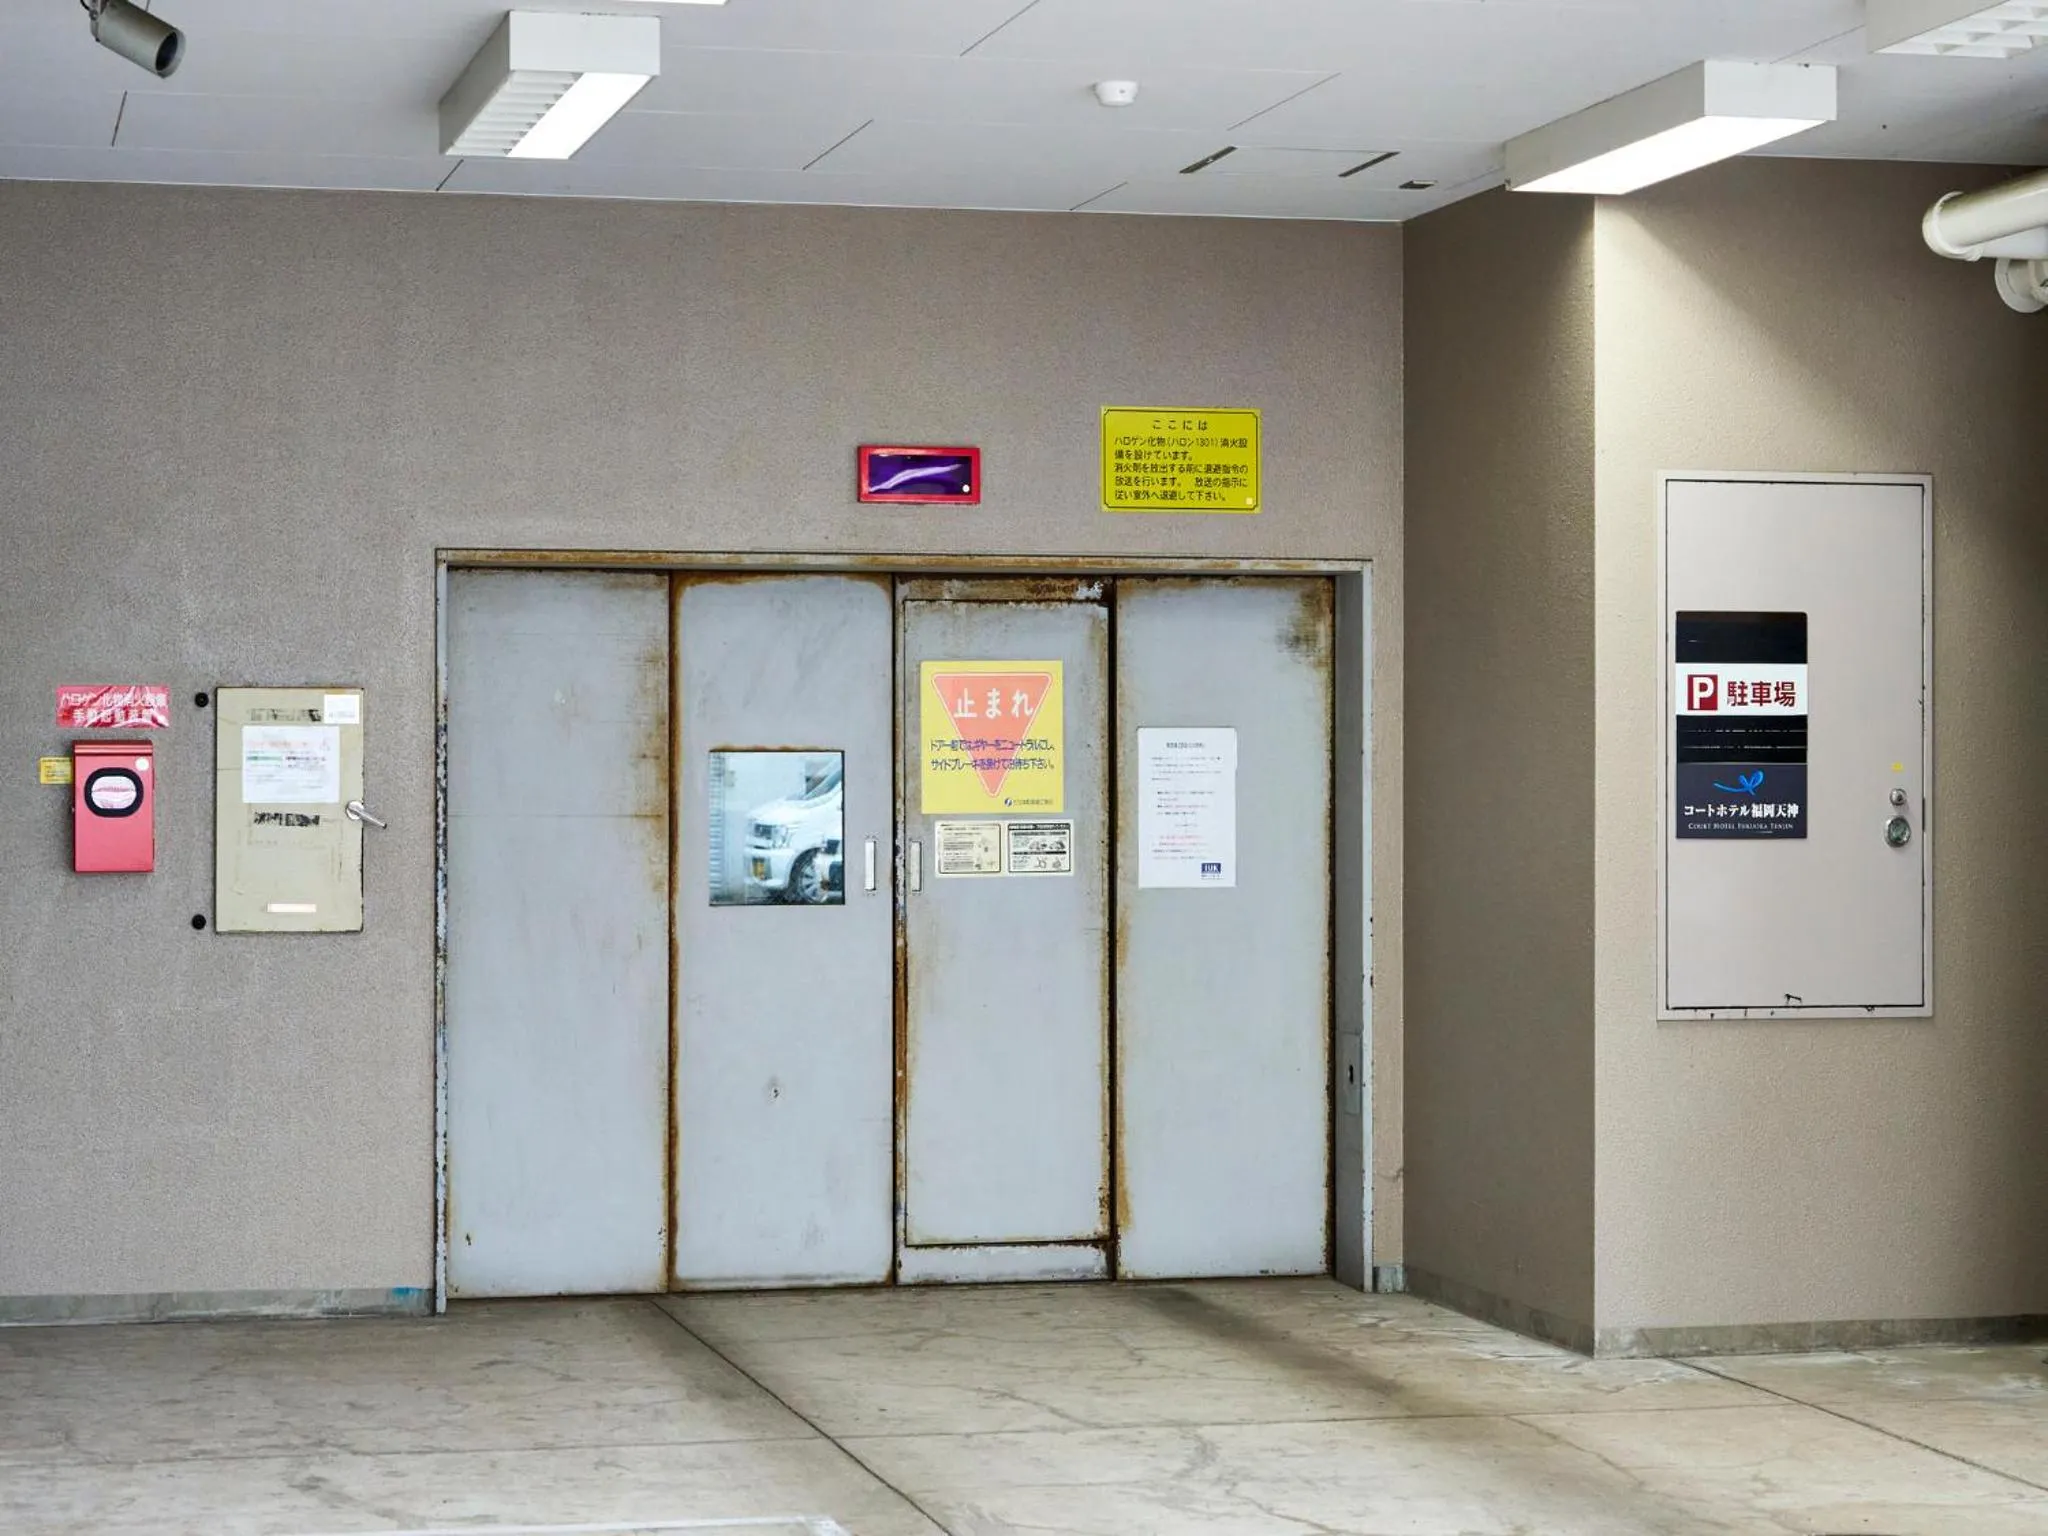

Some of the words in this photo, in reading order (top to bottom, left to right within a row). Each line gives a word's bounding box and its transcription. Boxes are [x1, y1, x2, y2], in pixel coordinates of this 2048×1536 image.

[1152, 419, 1208, 431] ここには
[953, 688, 1034, 719] 止まれ
[1692, 676, 1714, 710] P
[1727, 681, 1796, 707] 駐車場
[1684, 803, 1799, 818] コートホテル福岡天神
